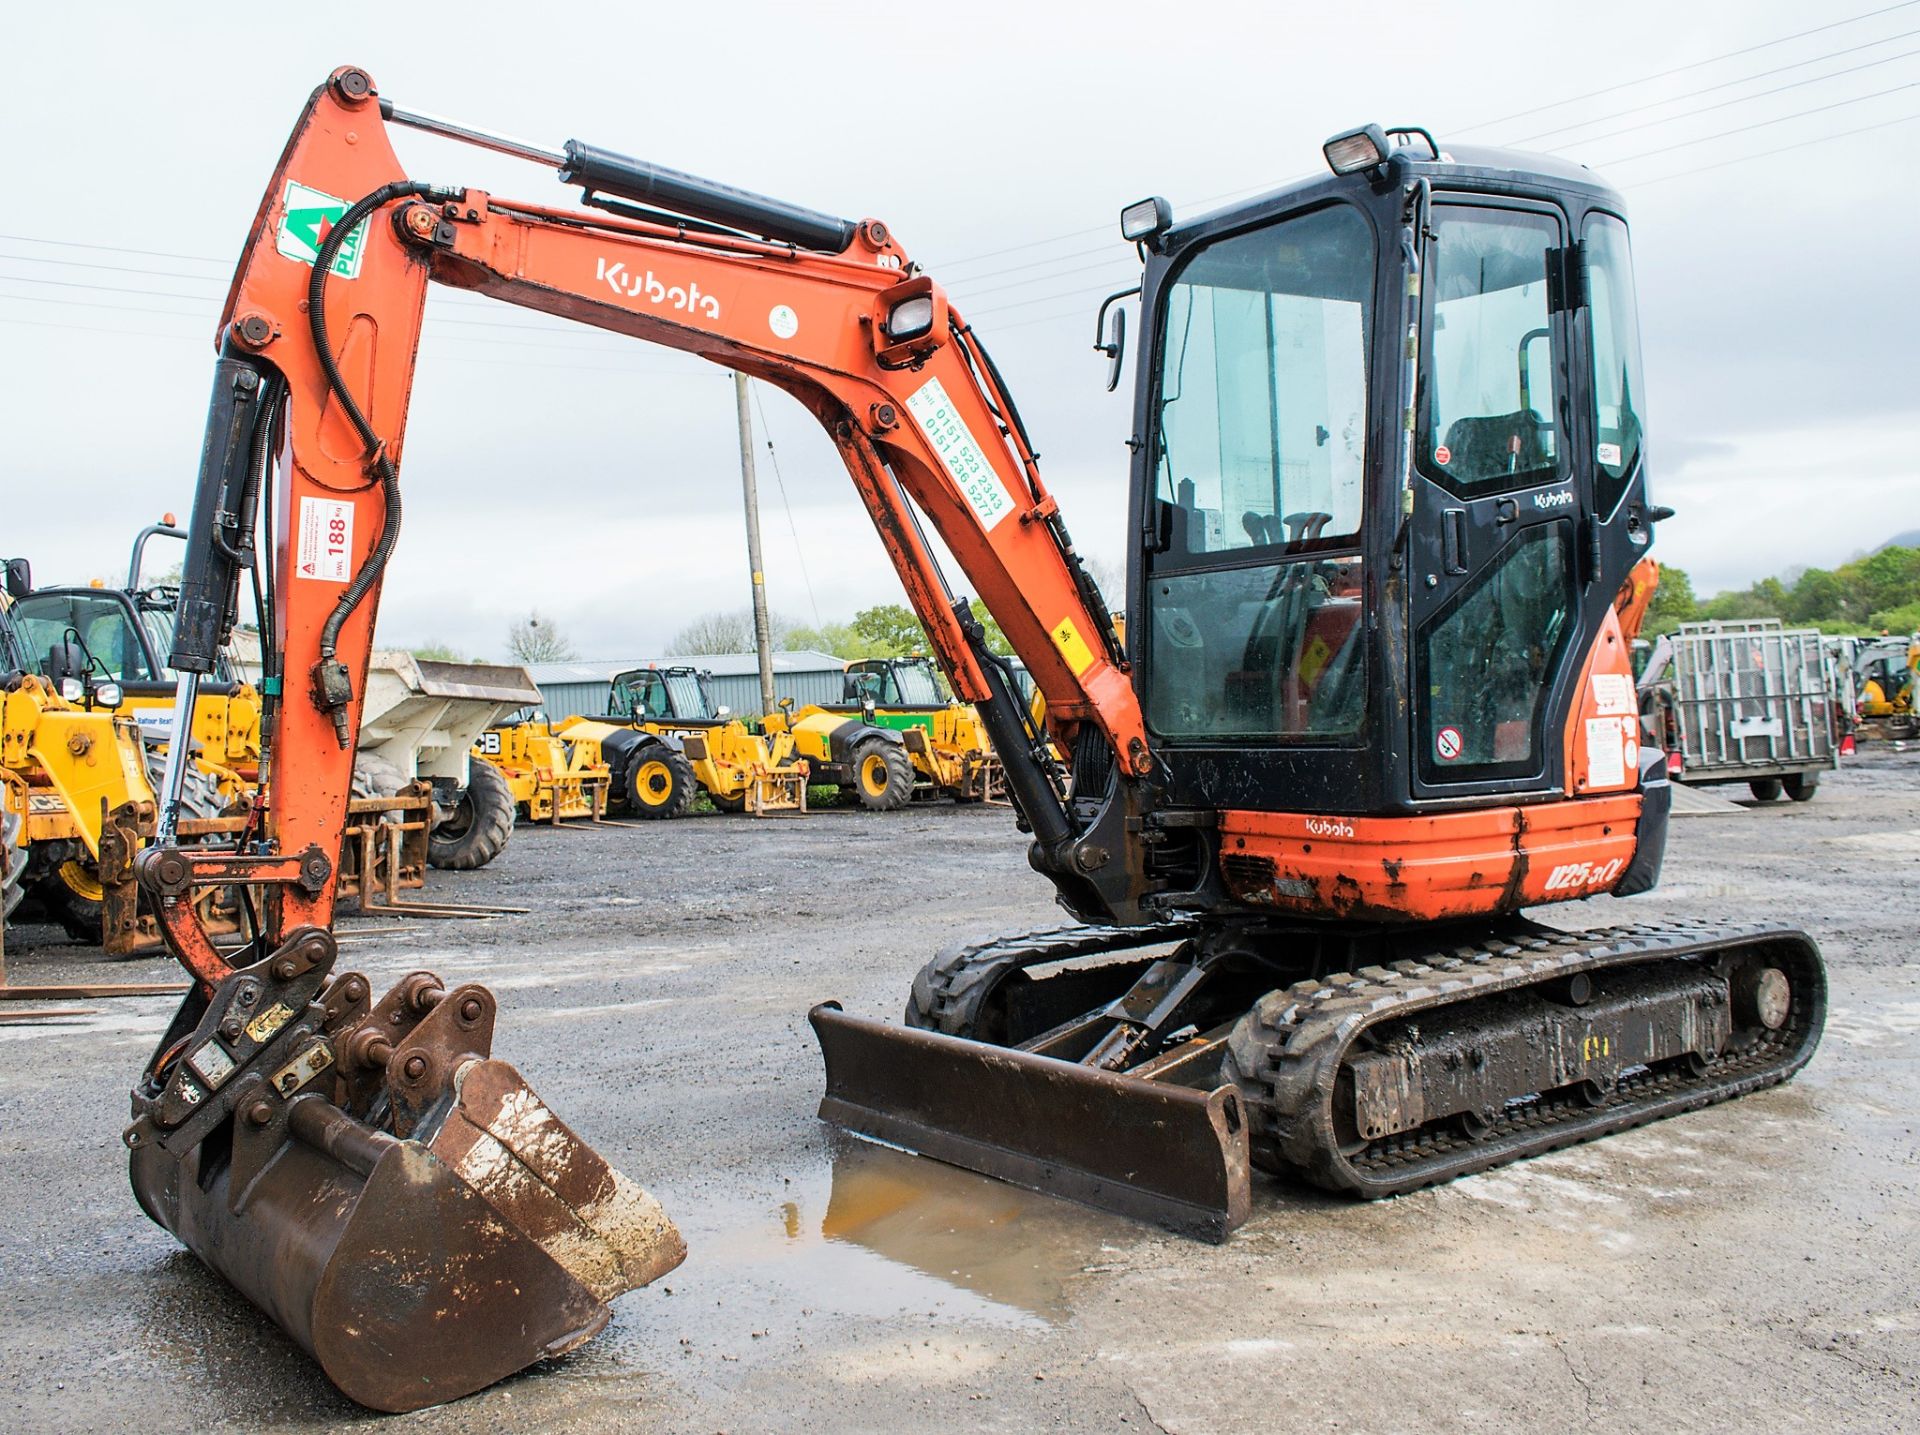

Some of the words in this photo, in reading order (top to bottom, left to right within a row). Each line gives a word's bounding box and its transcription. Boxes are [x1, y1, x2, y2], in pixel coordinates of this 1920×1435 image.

[337, 221, 363, 276] PLA
[596, 257, 720, 320] Kubota
[925, 417, 951, 453] 0151
[948, 455, 970, 483] 236
[967, 483, 993, 517] 5277
[935, 408, 961, 444] 0151
[959, 445, 980, 473] 523
[977, 474, 1003, 510] 2343
[1533, 489, 1573, 508] Kubota
[327, 519, 346, 556] 188
[1305, 818, 1355, 838] Kubota
